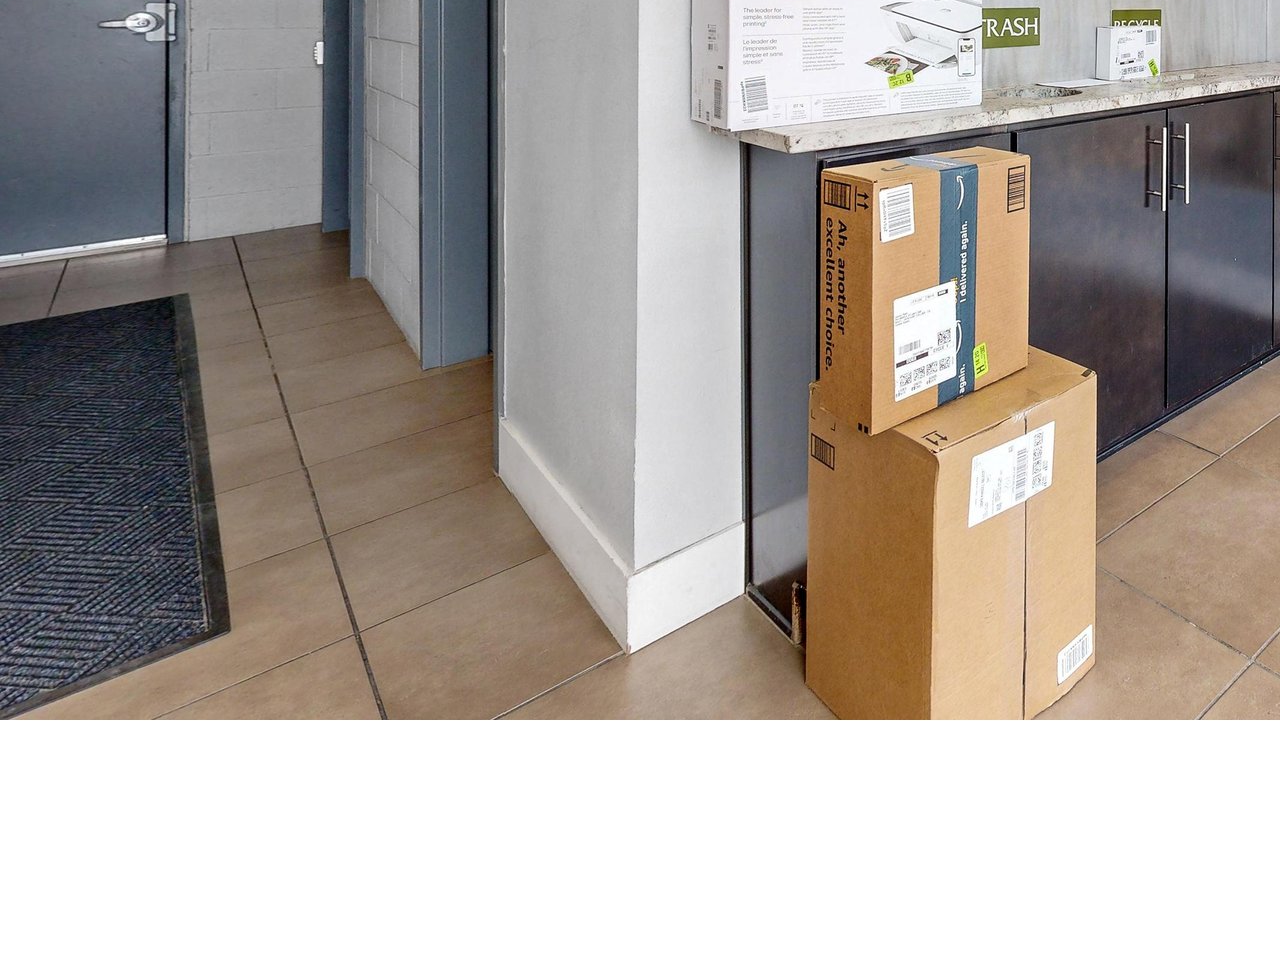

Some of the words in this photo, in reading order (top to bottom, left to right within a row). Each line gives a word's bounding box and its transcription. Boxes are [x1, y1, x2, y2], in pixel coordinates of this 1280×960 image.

[742, 44, 777, 52] l'impression
[837, 219, 848, 251] Ah,
[960, 220, 969, 251] again.
[825, 216, 836, 303] excellent
[959, 251, 968, 295] delivered
[837, 257, 848, 336] another
[824, 307, 835, 371] choice.
[958, 363, 968, 394] again.
